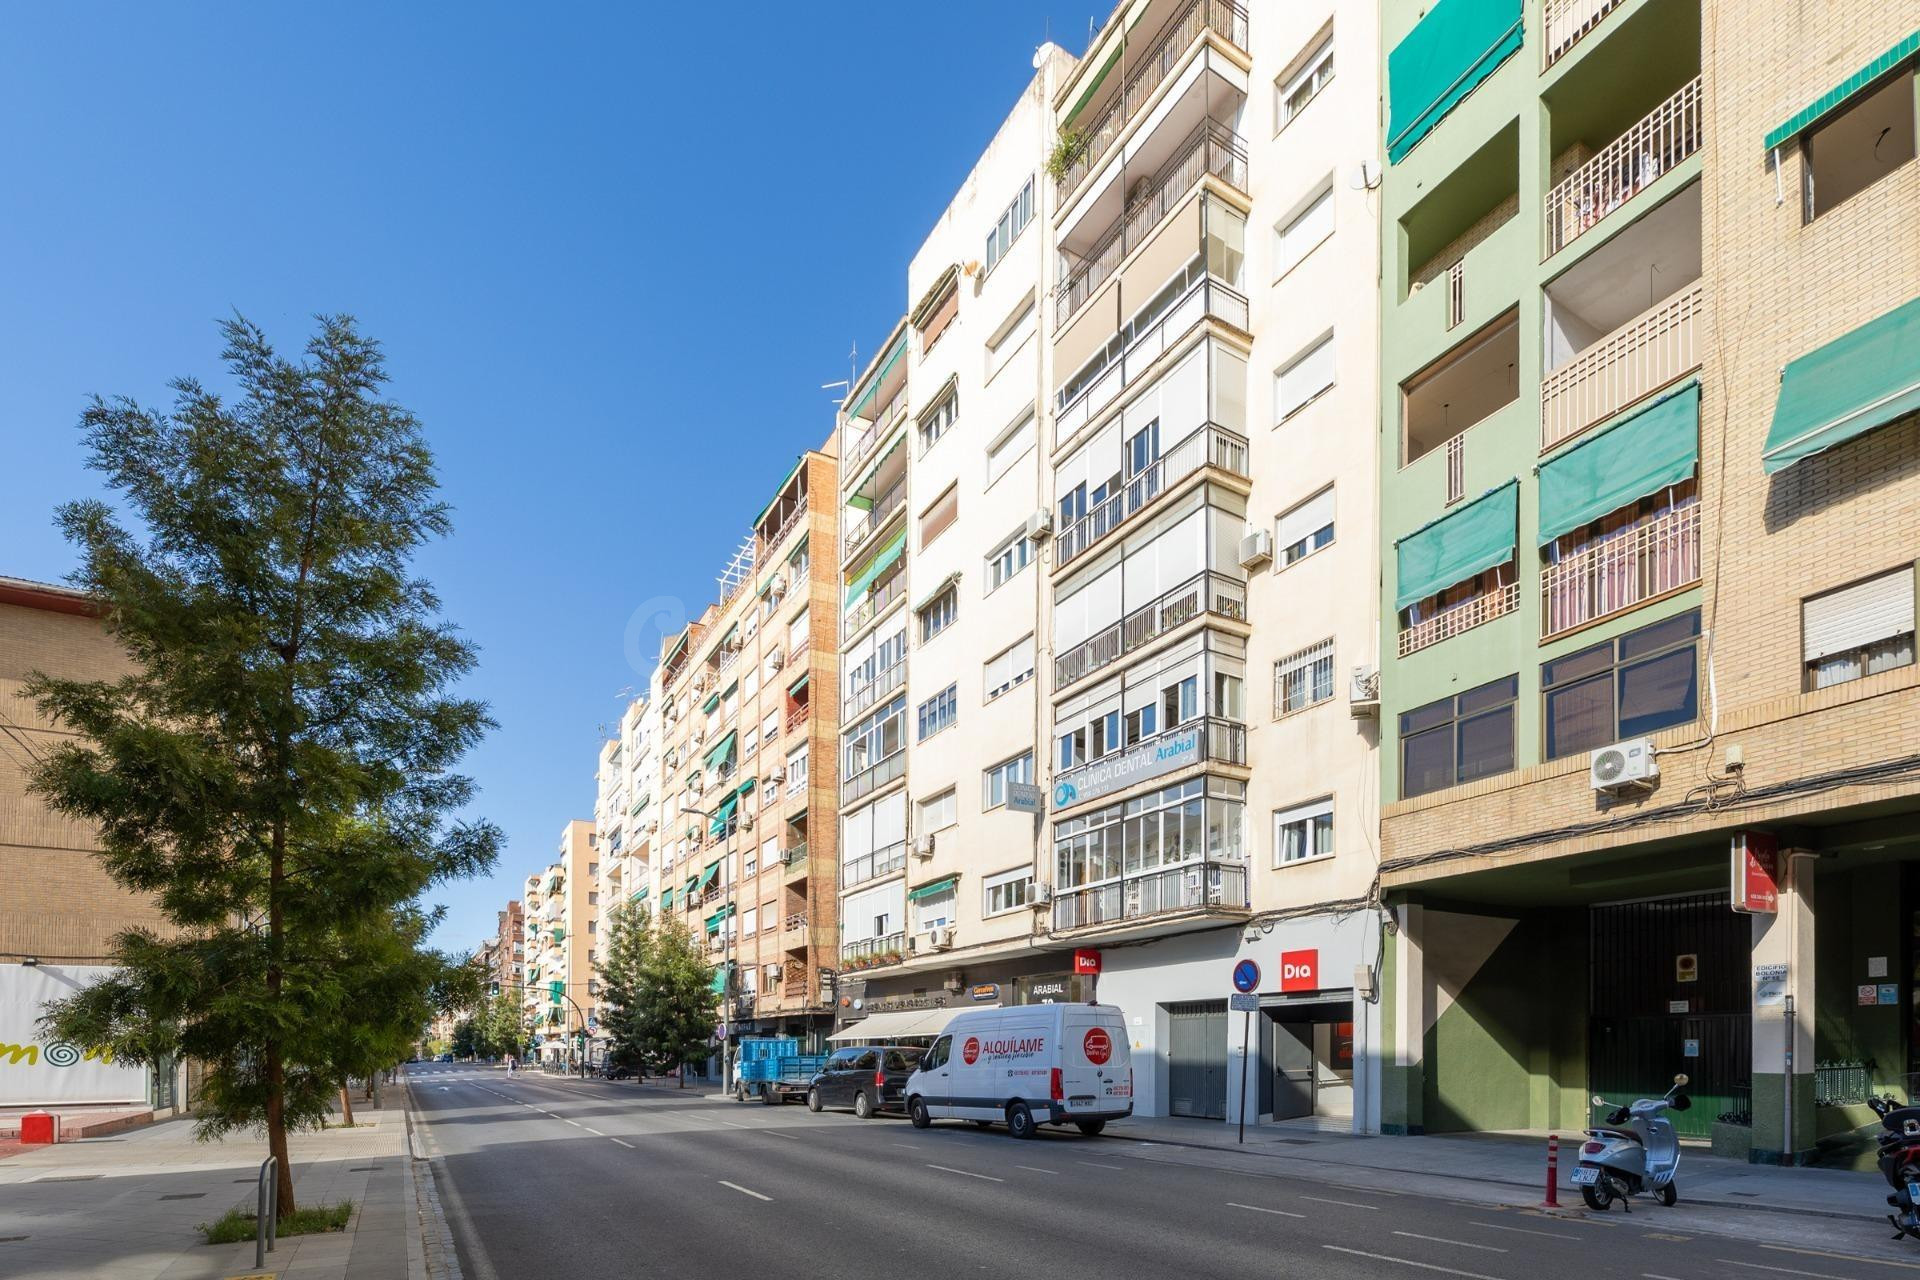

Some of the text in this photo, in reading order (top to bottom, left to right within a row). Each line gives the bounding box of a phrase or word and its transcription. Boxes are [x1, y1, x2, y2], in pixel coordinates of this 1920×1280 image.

[1114, 755, 1152, 779] DENTAL
[1155, 734, 1195, 762] Arabial
[1013, 797, 1036, 806] Arabial
[1033, 984, 1063, 995] ARABIAL
[983, 1036, 1044, 1054] ALQUÍLAME
